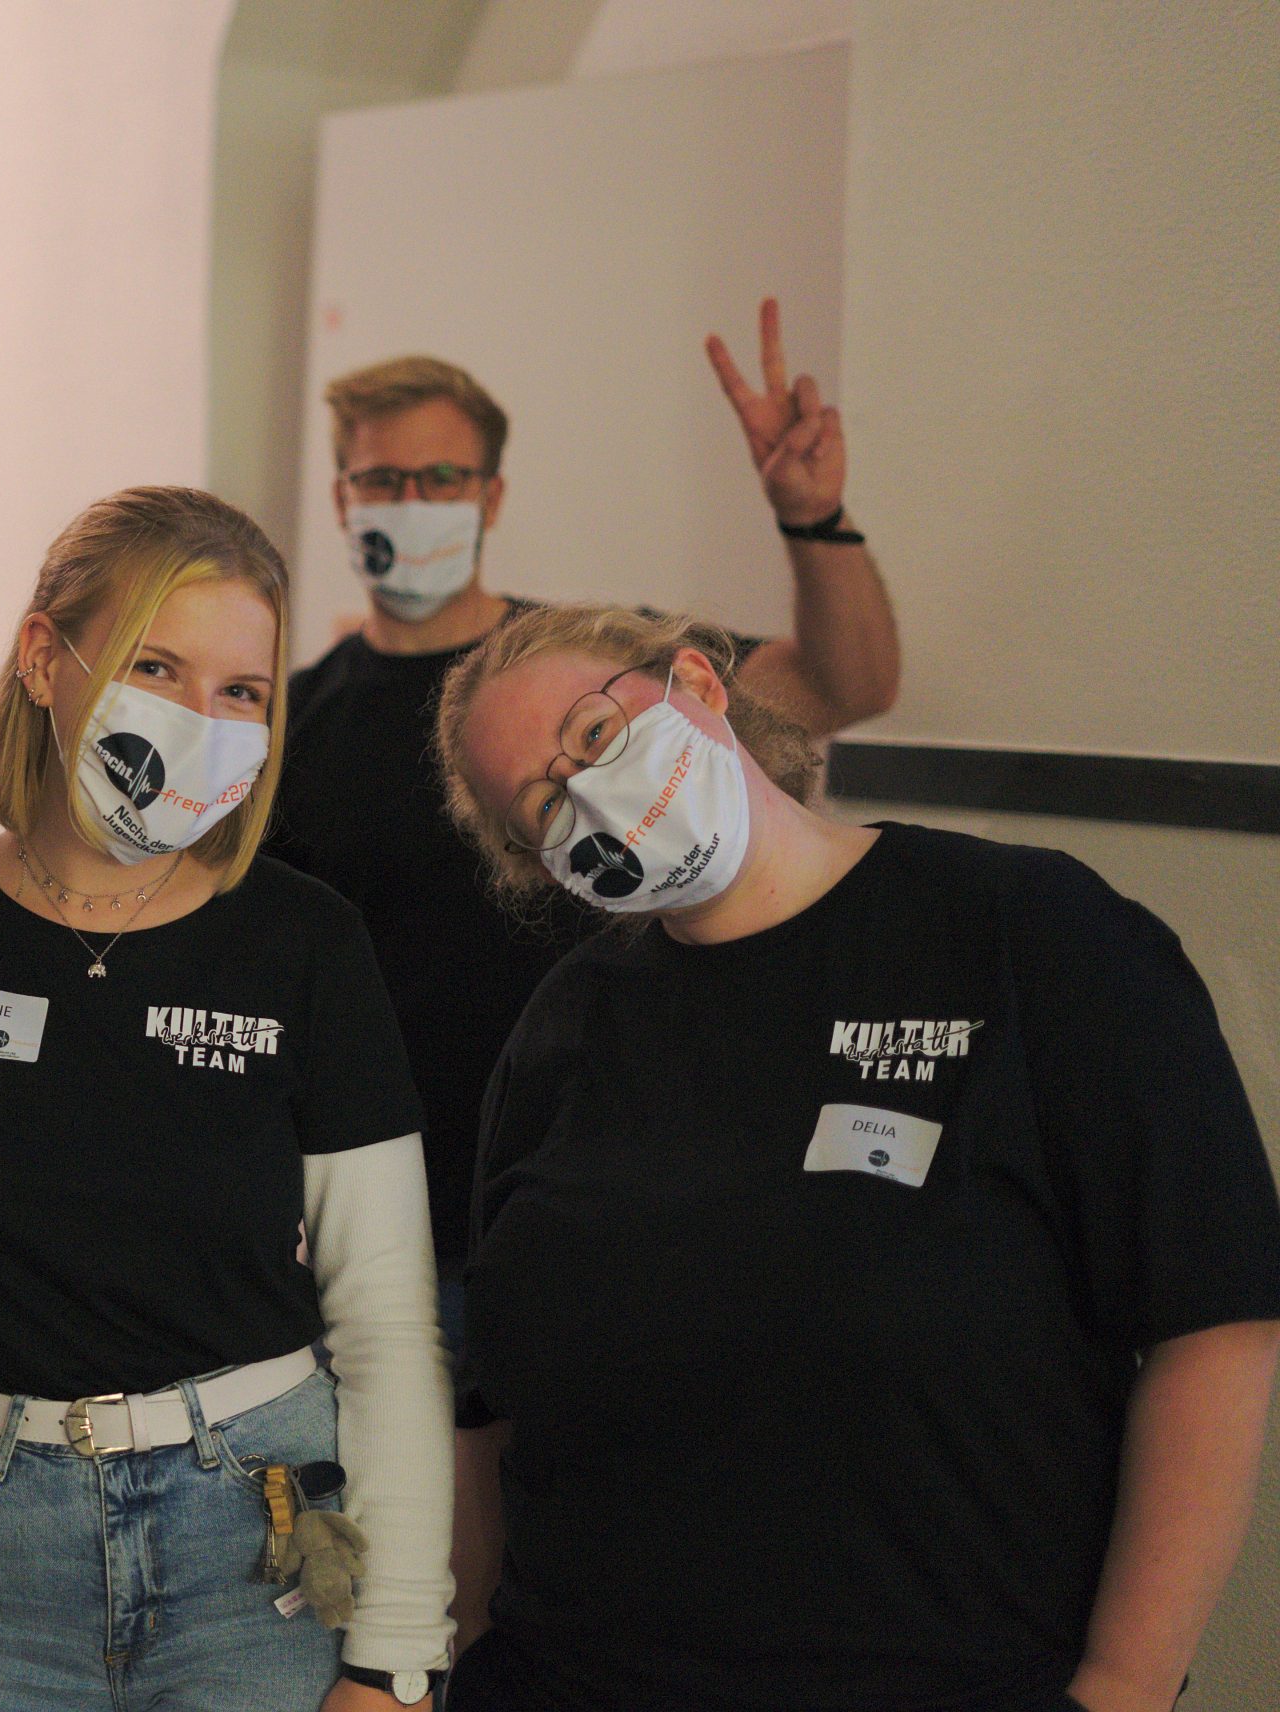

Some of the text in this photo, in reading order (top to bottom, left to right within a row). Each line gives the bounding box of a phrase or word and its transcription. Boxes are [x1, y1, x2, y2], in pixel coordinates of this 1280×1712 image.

[114, 805, 173, 851] Nacht der
[683, 844, 702, 867] der
[146, 1006, 280, 1055] KULTUR
[829, 1020, 970, 1057] KULTUR
[175, 1045, 245, 1074] TEAM
[859, 1059, 935, 1081] TEAM
[851, 1119, 896, 1138] DELIA
